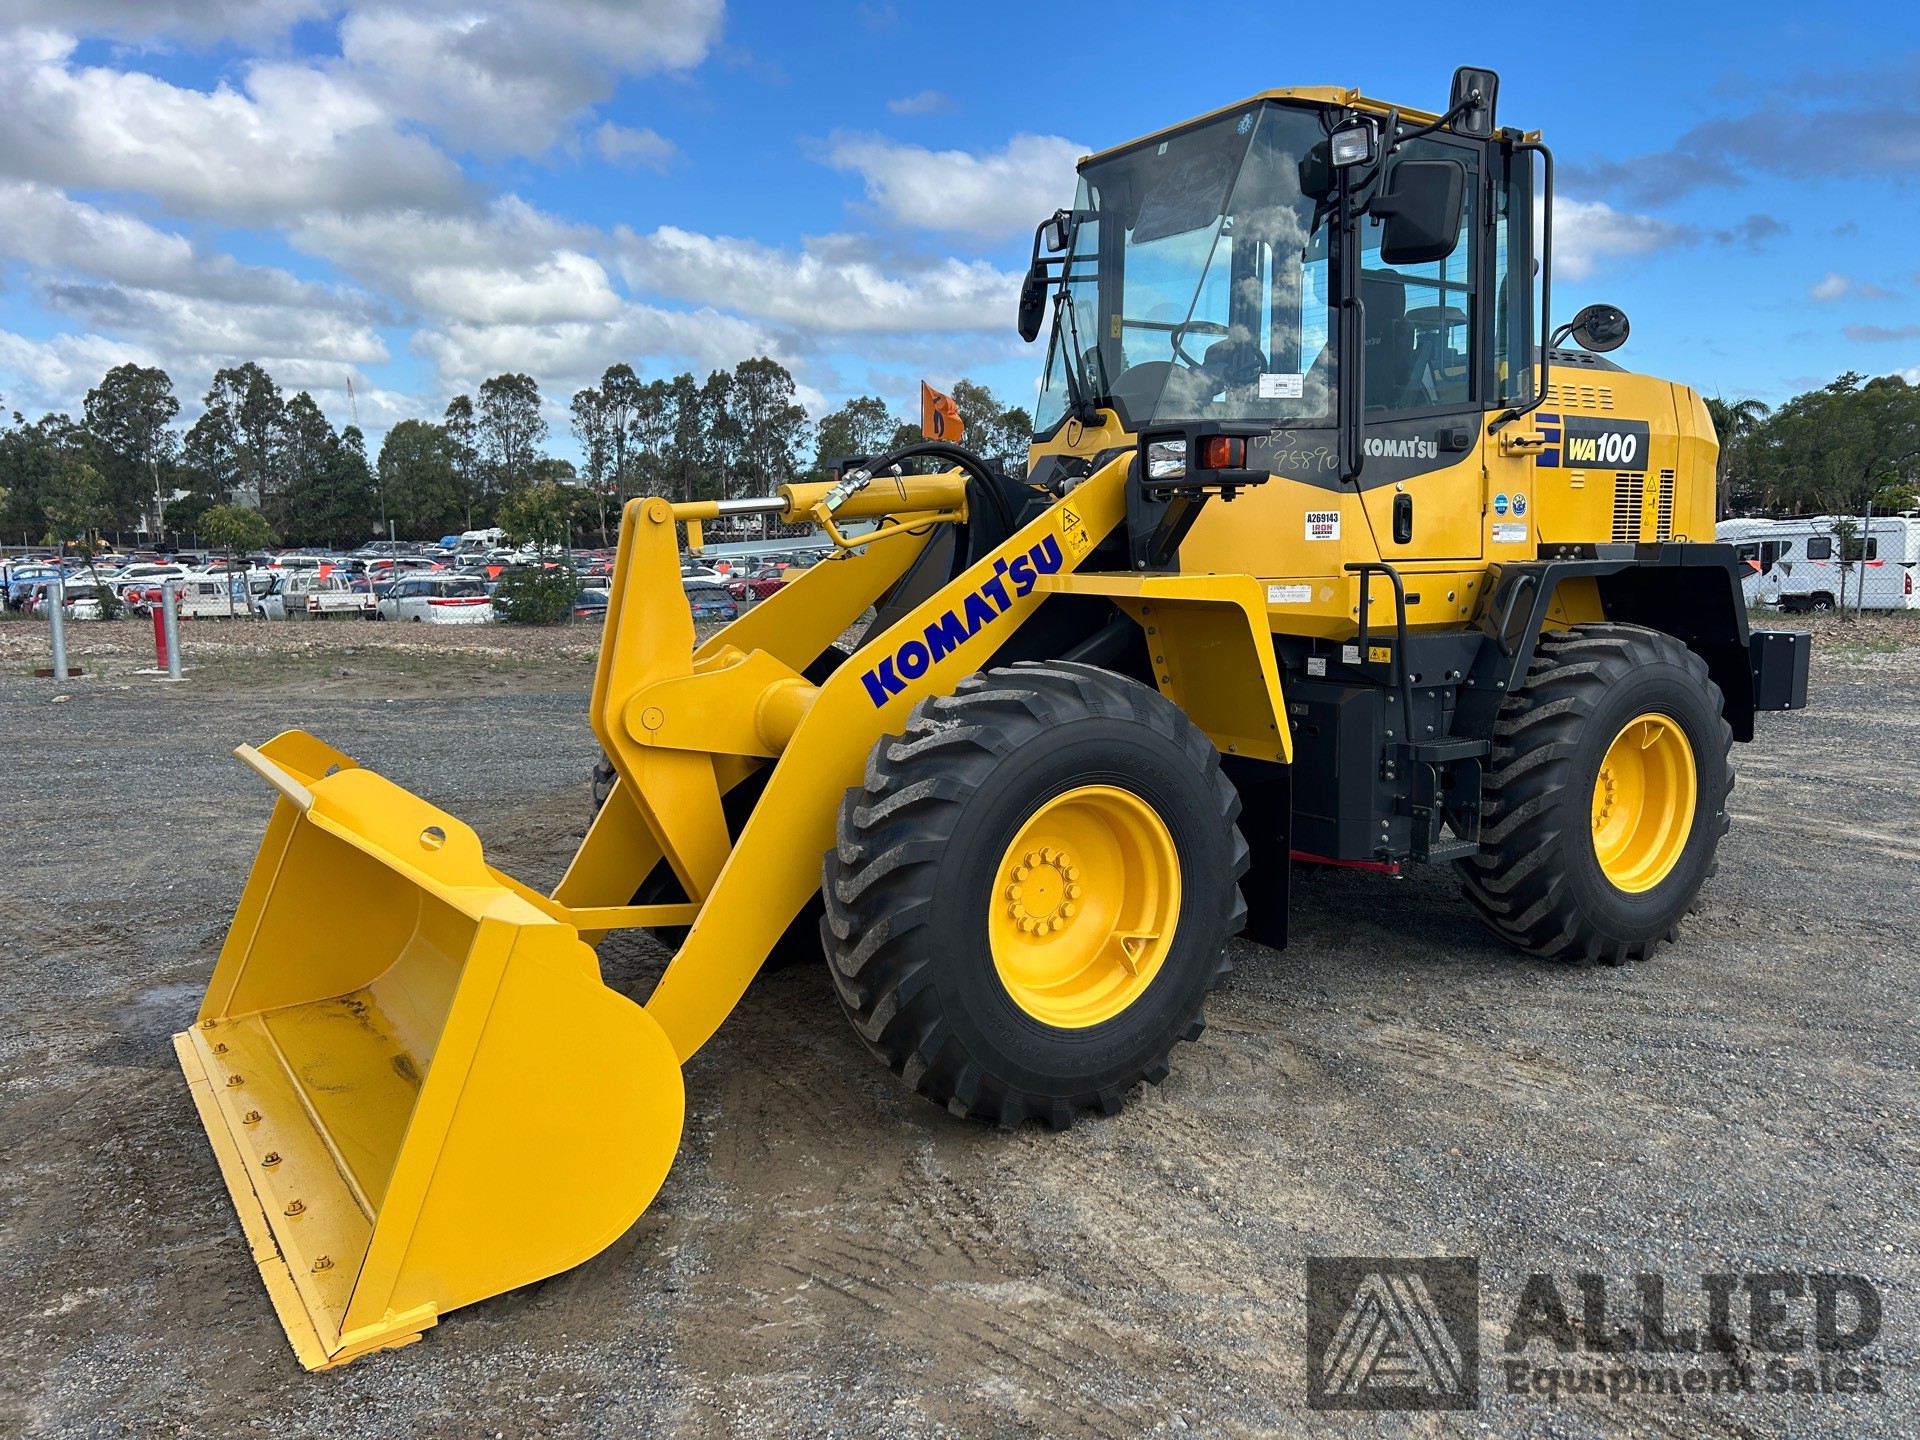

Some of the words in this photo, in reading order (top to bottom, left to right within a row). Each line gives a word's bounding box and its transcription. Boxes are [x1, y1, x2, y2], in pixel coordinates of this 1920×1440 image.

[1273, 446, 1340, 473] 95890
[1569, 432, 1637, 464] WA100
[1307, 513, 1339, 523] A269143
[861, 533, 1064, 709] KOMATSU
